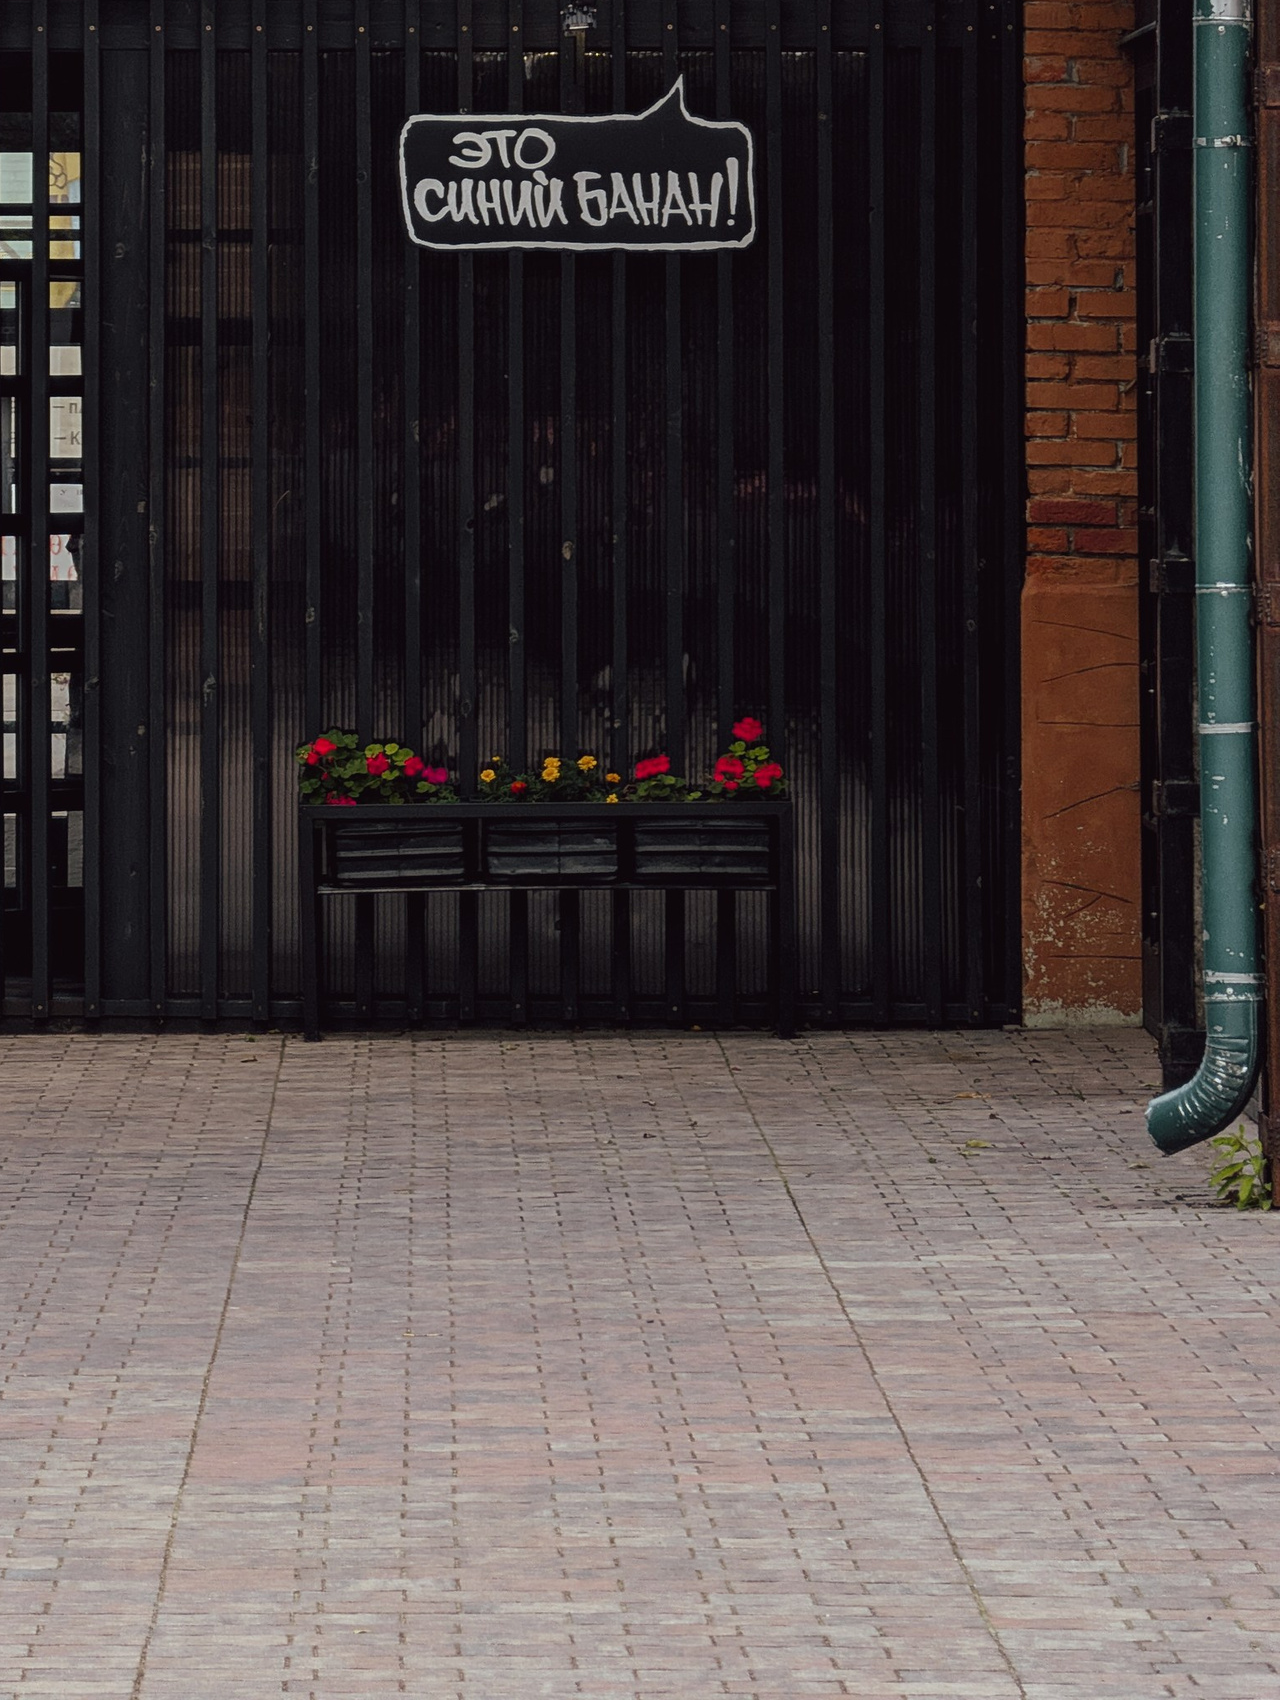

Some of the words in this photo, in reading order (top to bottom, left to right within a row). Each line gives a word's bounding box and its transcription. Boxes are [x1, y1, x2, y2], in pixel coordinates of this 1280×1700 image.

[448, 127, 556, 170] ЭТО
[414, 170, 569, 228] СИНИЙ
[572, 157, 739, 228] БАНАН!
